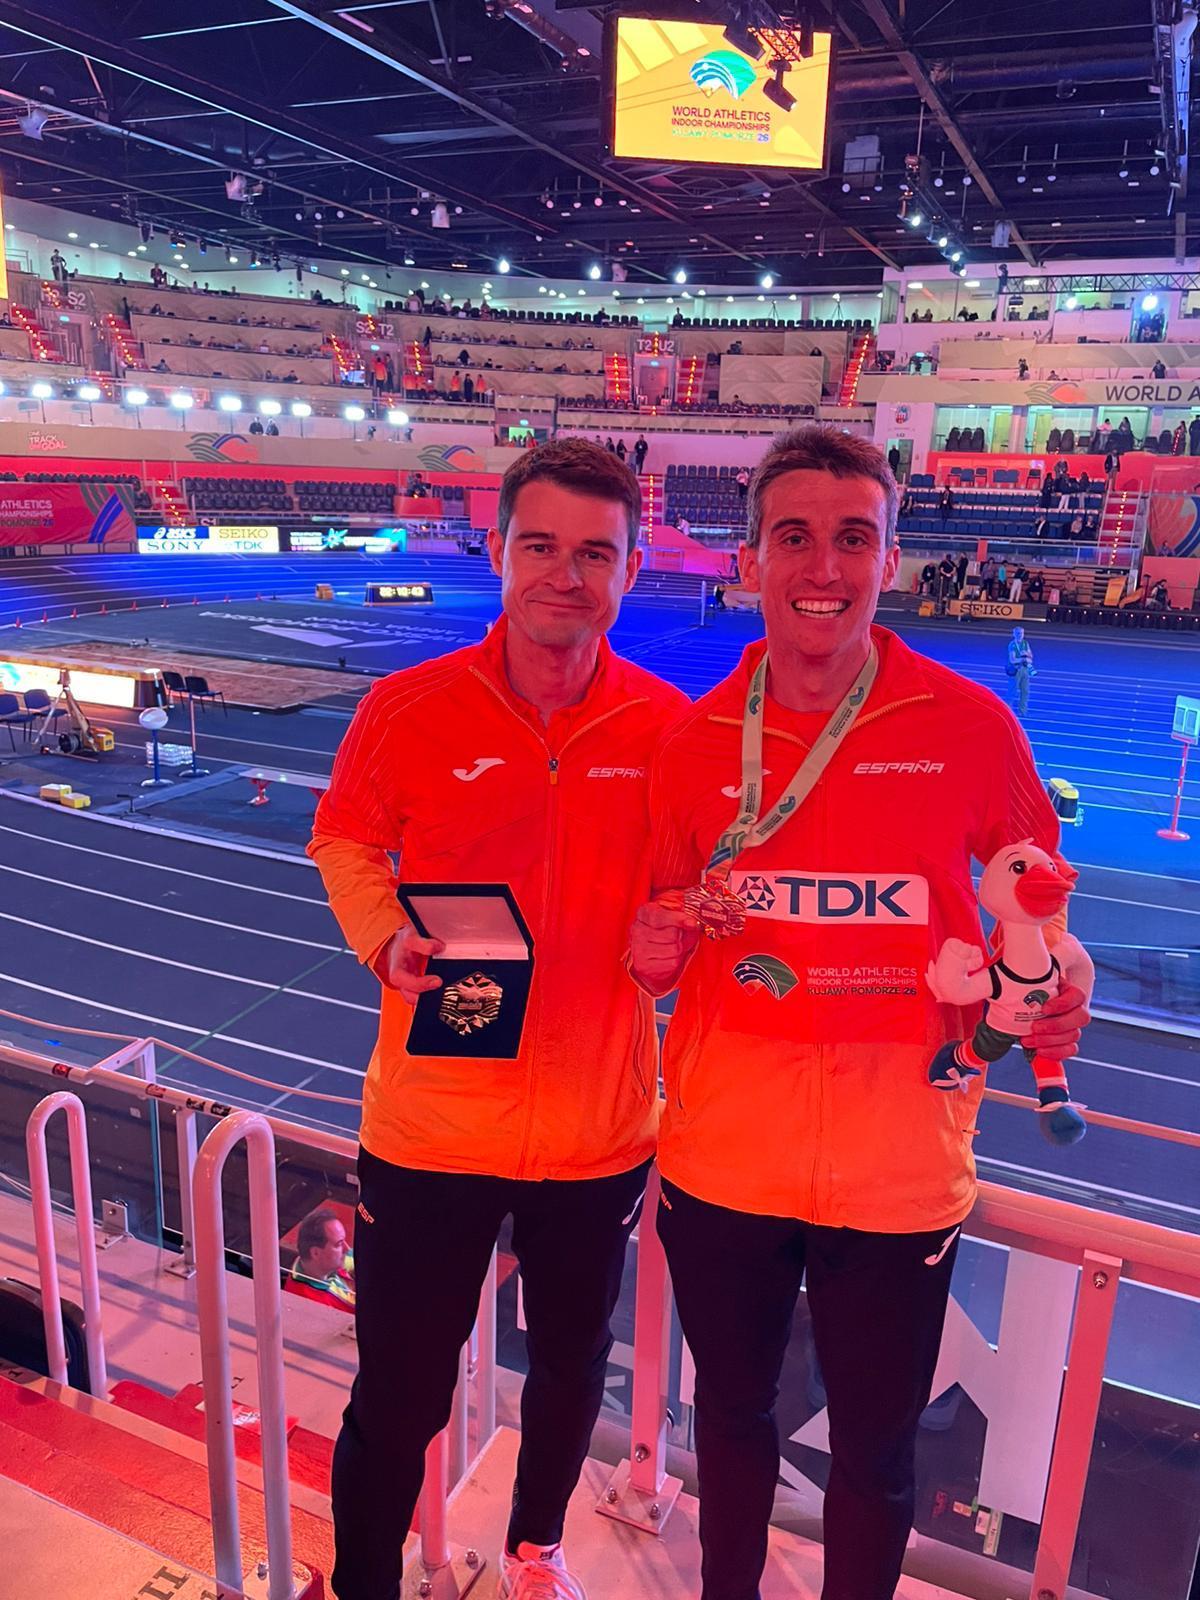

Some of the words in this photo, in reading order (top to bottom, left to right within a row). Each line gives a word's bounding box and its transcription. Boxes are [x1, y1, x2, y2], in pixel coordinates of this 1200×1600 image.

[672, 105, 711, 118] WORLD
[713, 109, 771, 122] ATHLETICS
[671, 118, 703, 127] INDOOR
[703, 120, 770, 131] CHAMPIONSHIPS
[757, 133, 769, 141] 26
[67, 291, 87, 306] S2
[378, 323, 395, 336] T2
[637, 339, 653, 351] T2
[659, 340, 675, 352] U2
[1105, 385, 1183, 401] WORLD
[1, 499, 53, 509] ATHLETICS
[218, 528, 269, 539] SEIKO
[147, 541, 203, 551] SONY
[234, 541, 264, 550] TDK
[960, 603, 1013, 616] SEIKO
[852, 759, 945, 774] ESPAÑA
[774, 876, 912, 917] TDK
[807, 967, 851, 977] WORLD
[853, 967, 918, 977] ATHLETICS
[806, 978, 841, 986] INDOOR
[843, 978, 918, 986] CHAMPIONSHIPS
[807, 987, 848, 995] KUJAWY
[850, 986, 900, 995] POMORZE
[902, 987, 917, 996] 26
